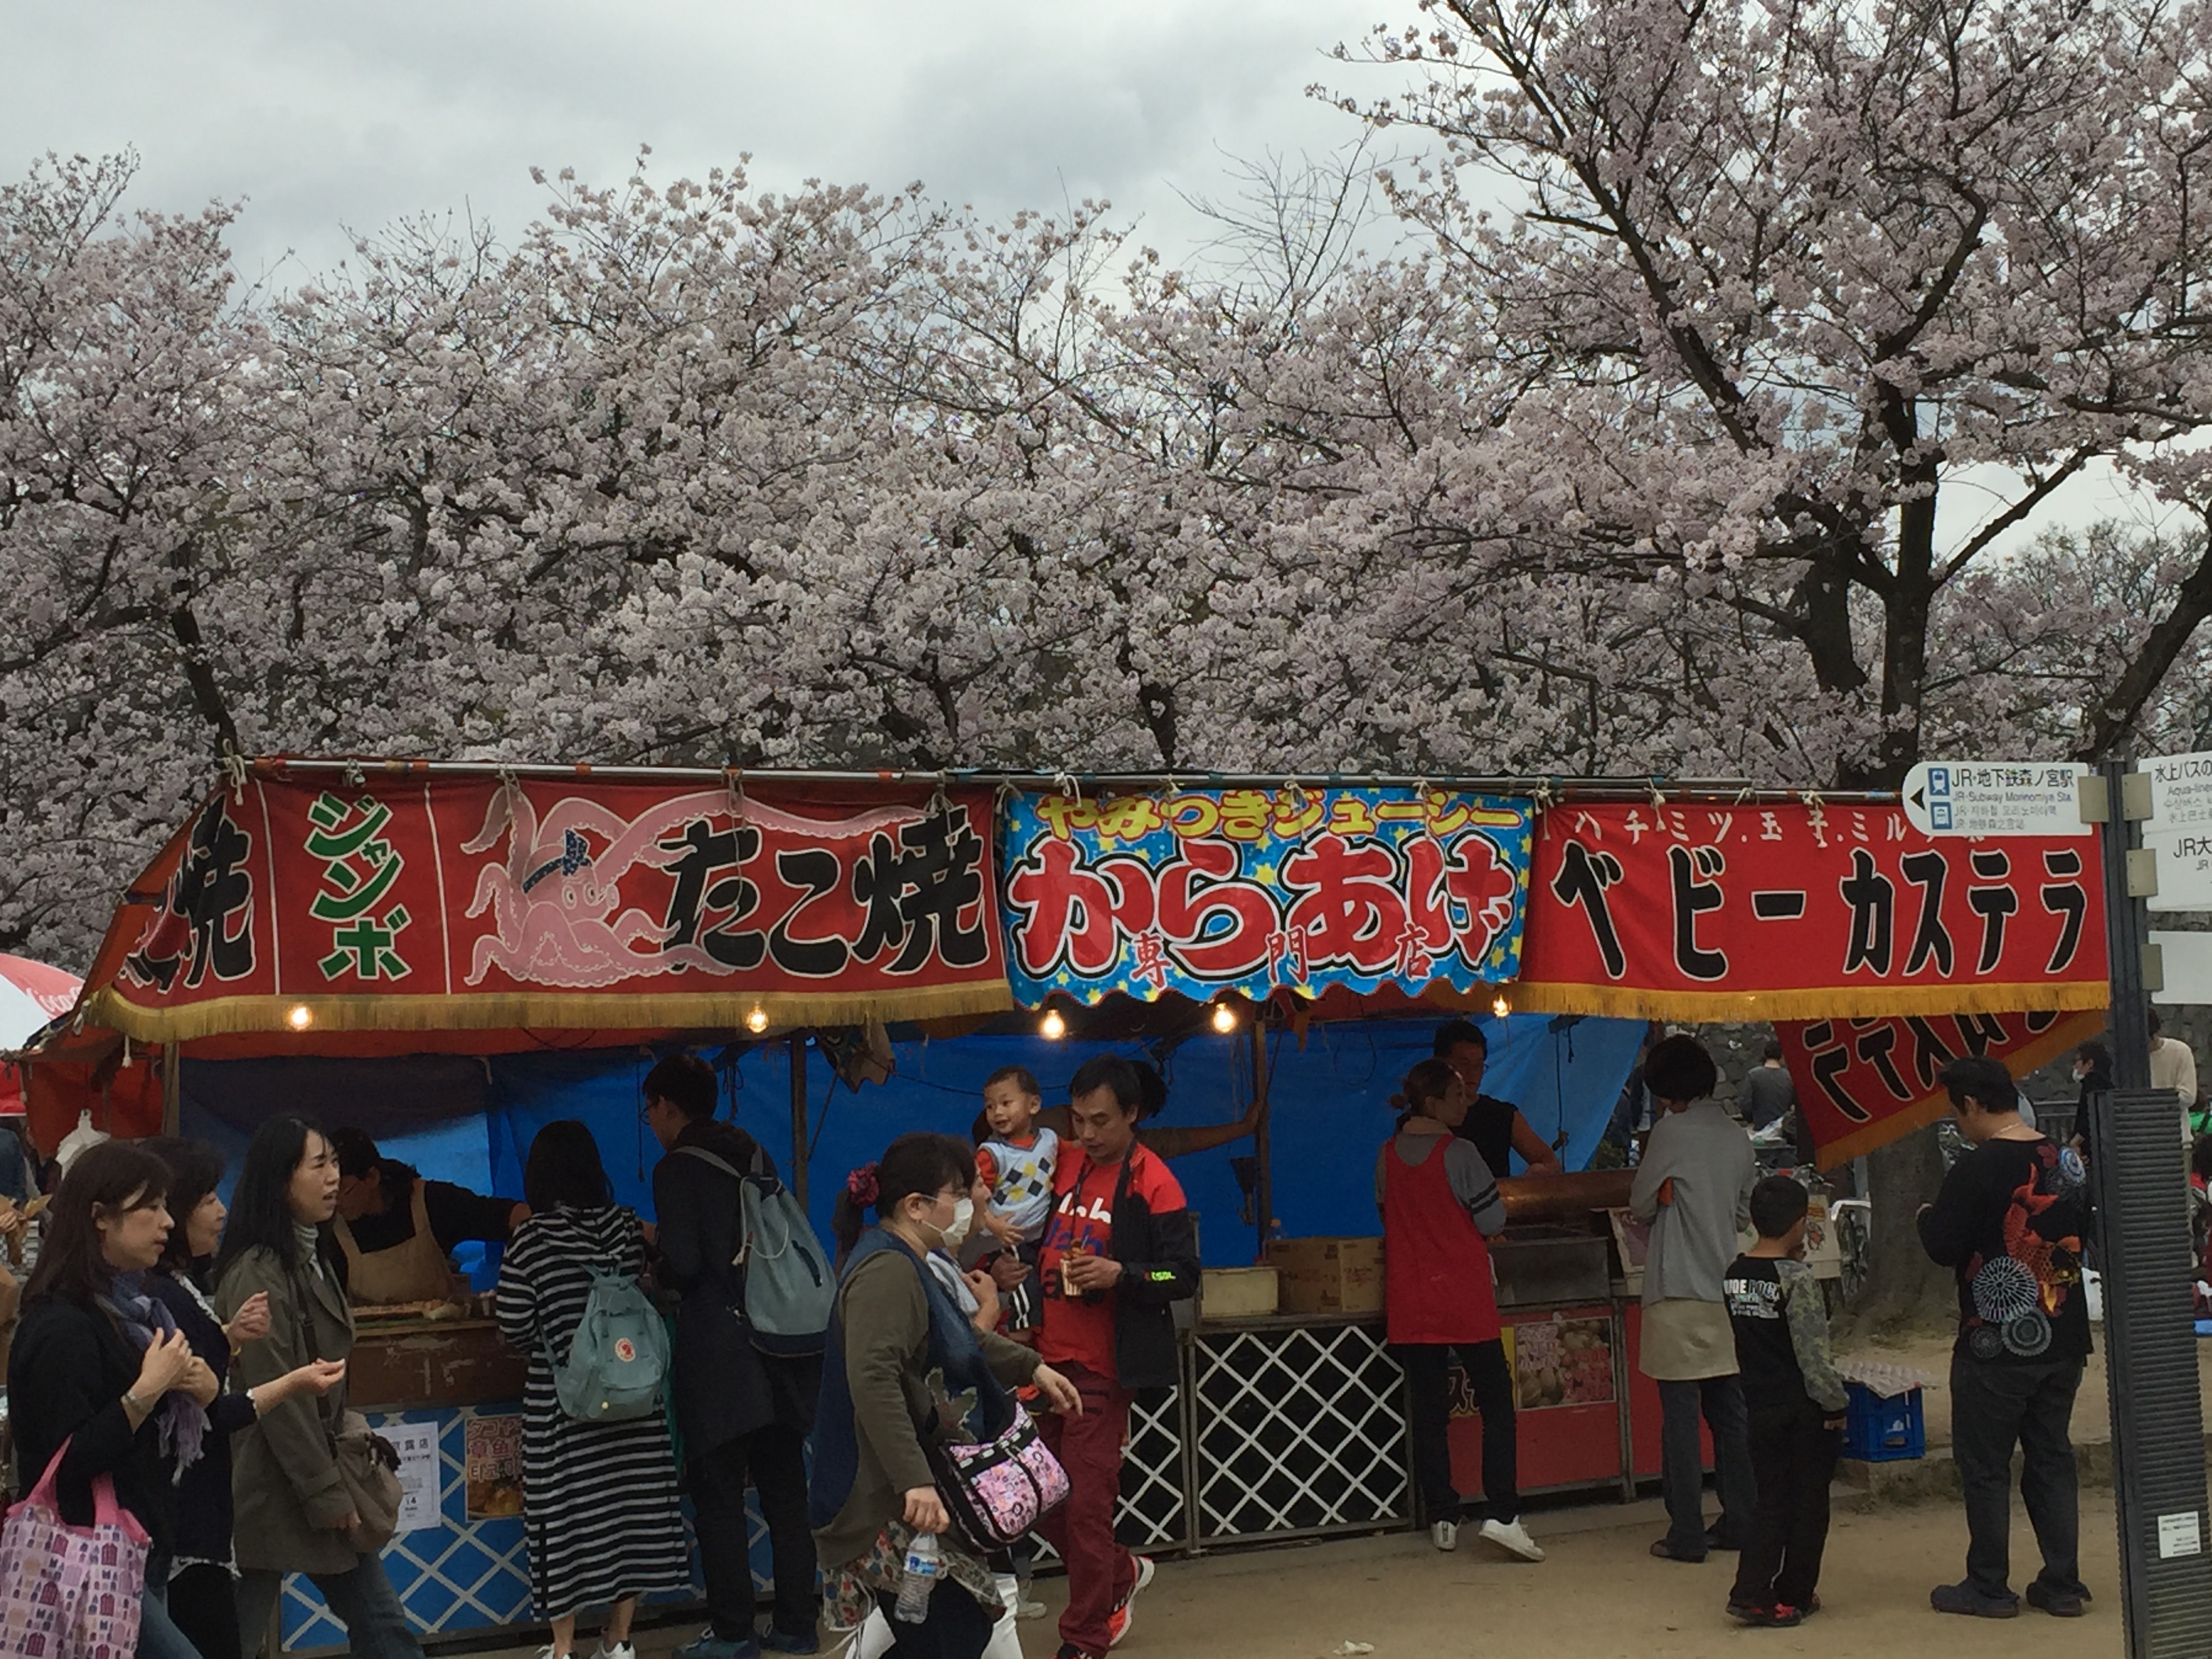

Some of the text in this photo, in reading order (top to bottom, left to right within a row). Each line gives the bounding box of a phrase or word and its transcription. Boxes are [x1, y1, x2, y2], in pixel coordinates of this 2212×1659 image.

[304, 790, 413, 982] ジャンボ
[657, 804, 991, 979] たこ焼
[1008, 830, 1517, 979] からあげ
[1550, 840, 2088, 981] ベビーカステラ
